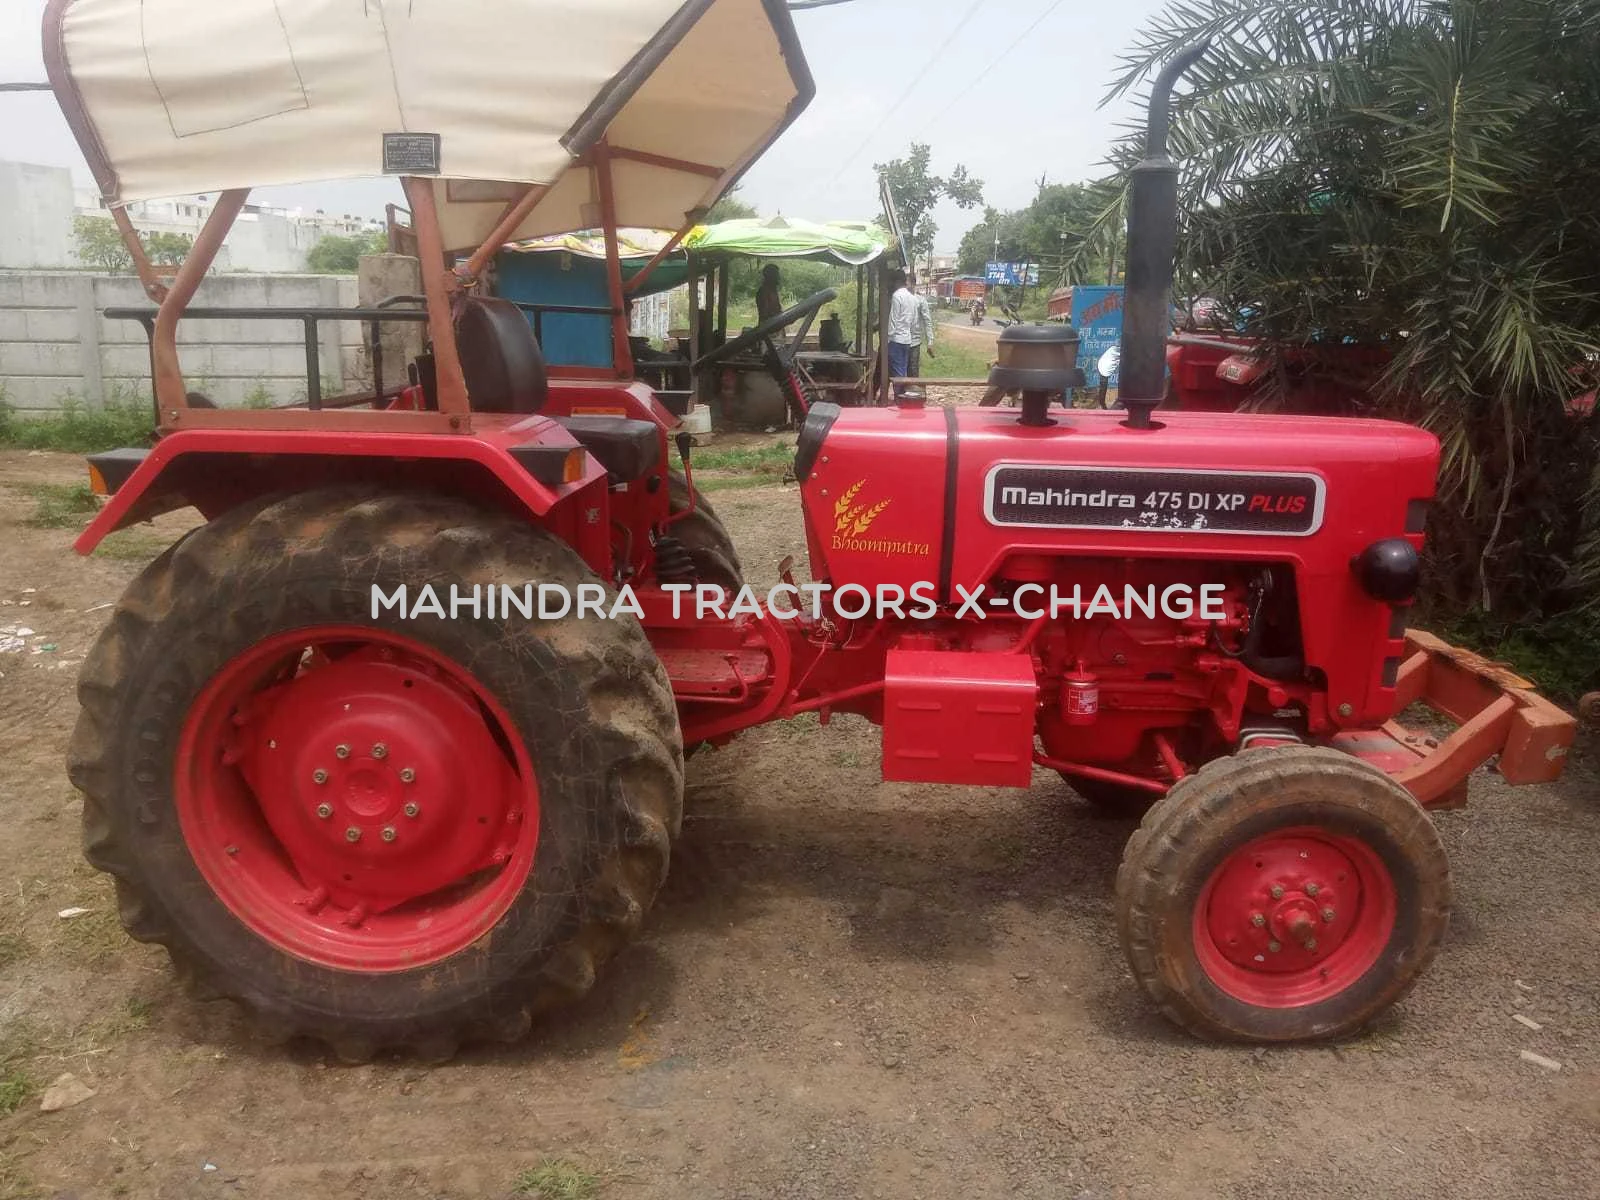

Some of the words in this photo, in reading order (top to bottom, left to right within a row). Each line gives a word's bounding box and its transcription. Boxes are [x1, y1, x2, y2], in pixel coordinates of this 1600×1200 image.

[1142, 491, 1182, 509] 475
[1188, 492, 1209, 510] DI
[1215, 493, 1245, 511] XP
[1248, 494, 1306, 513] PLUS
[831, 535, 930, 558] Bhoomiputra
